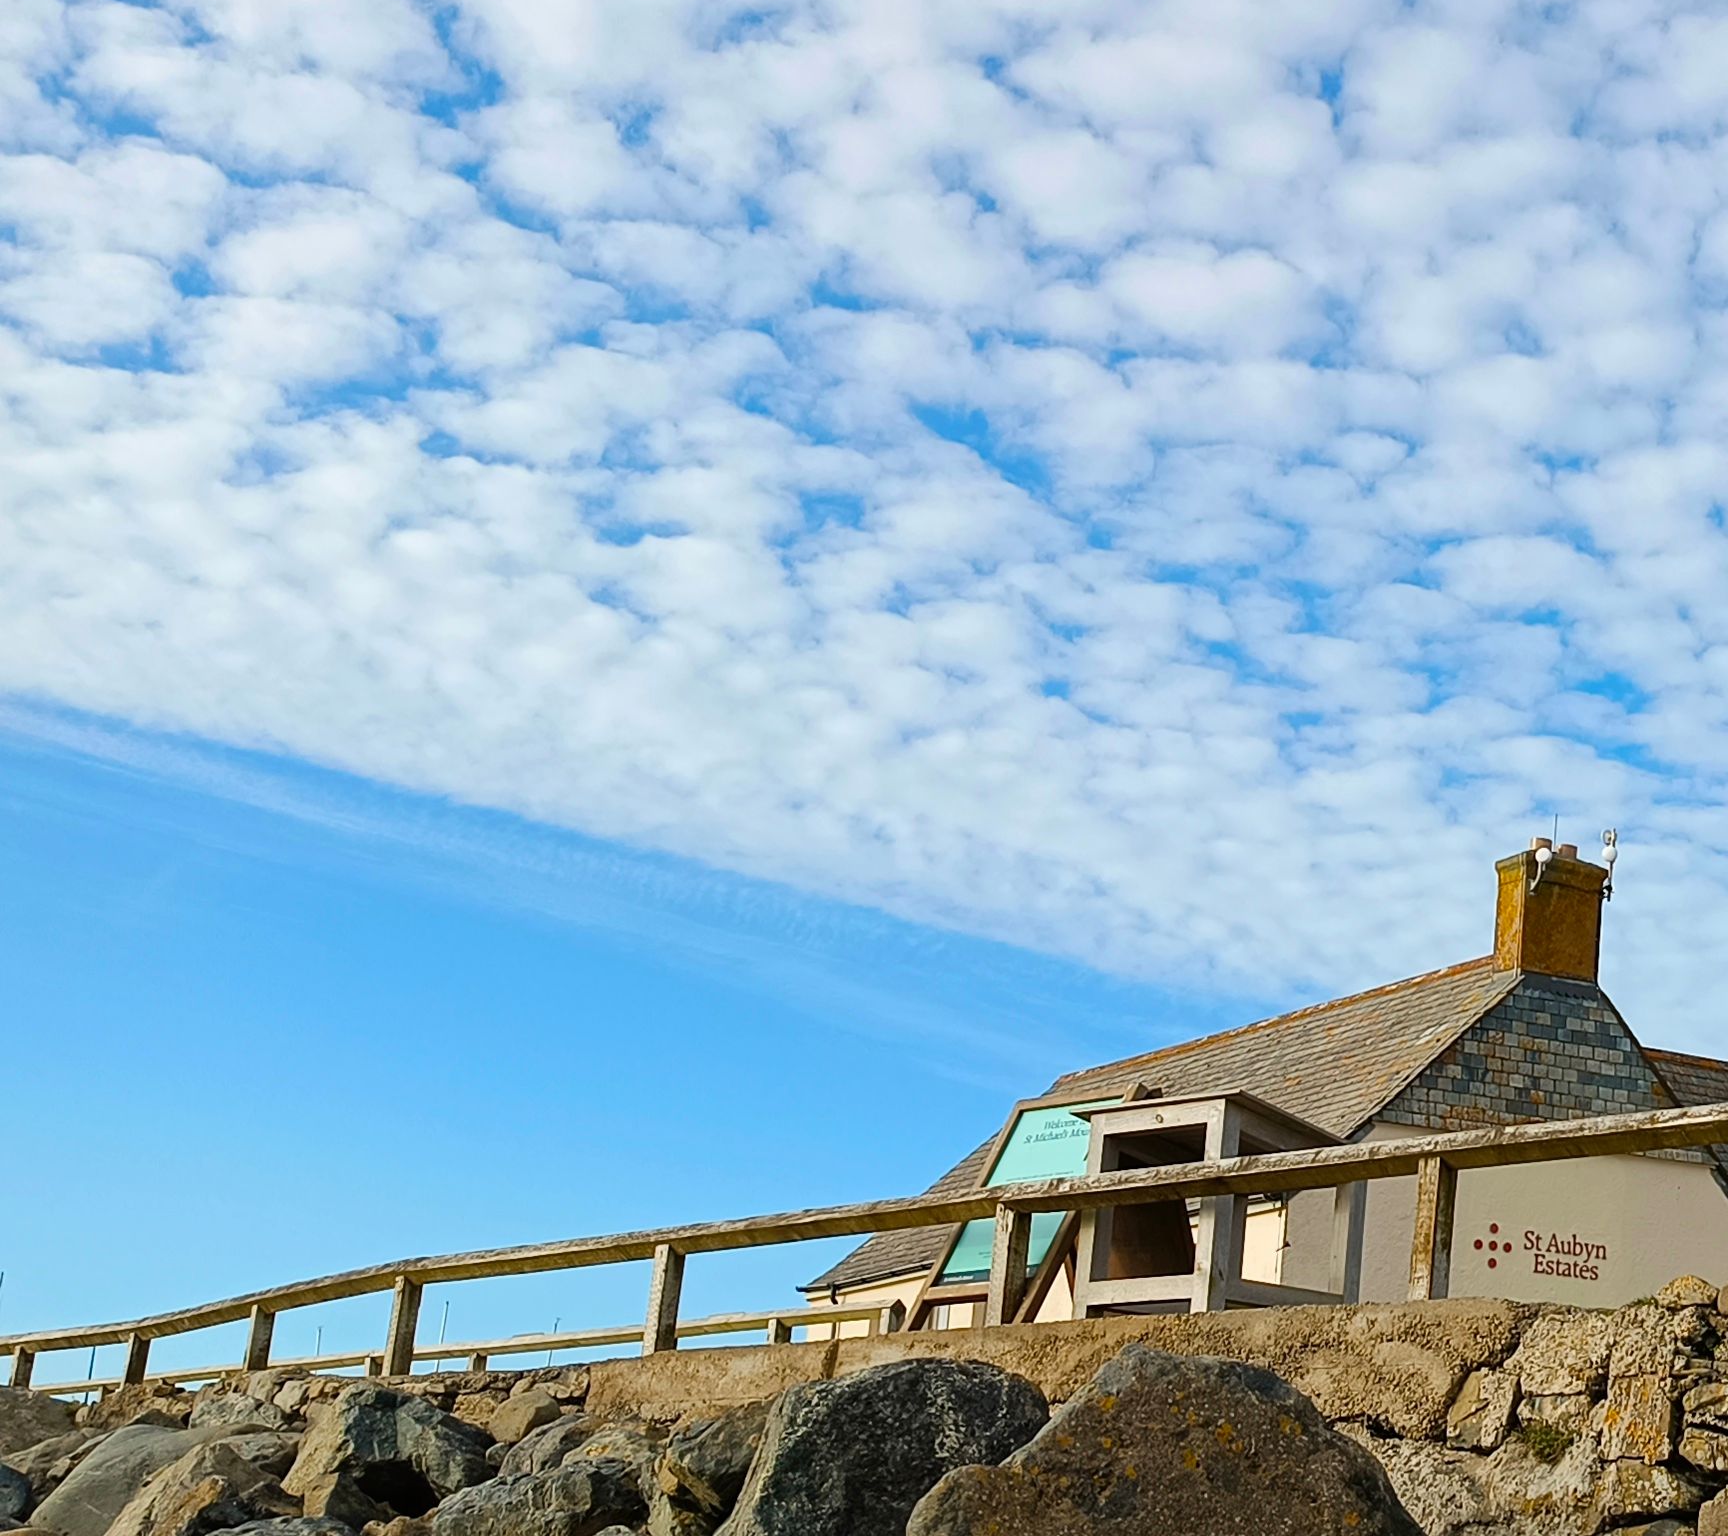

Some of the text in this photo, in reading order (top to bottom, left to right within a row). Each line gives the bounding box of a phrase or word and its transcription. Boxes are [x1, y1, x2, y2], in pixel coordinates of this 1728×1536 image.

[1523, 1230, 1607, 1263] St Aubyn
[1533, 1253, 1599, 1281] Estates
